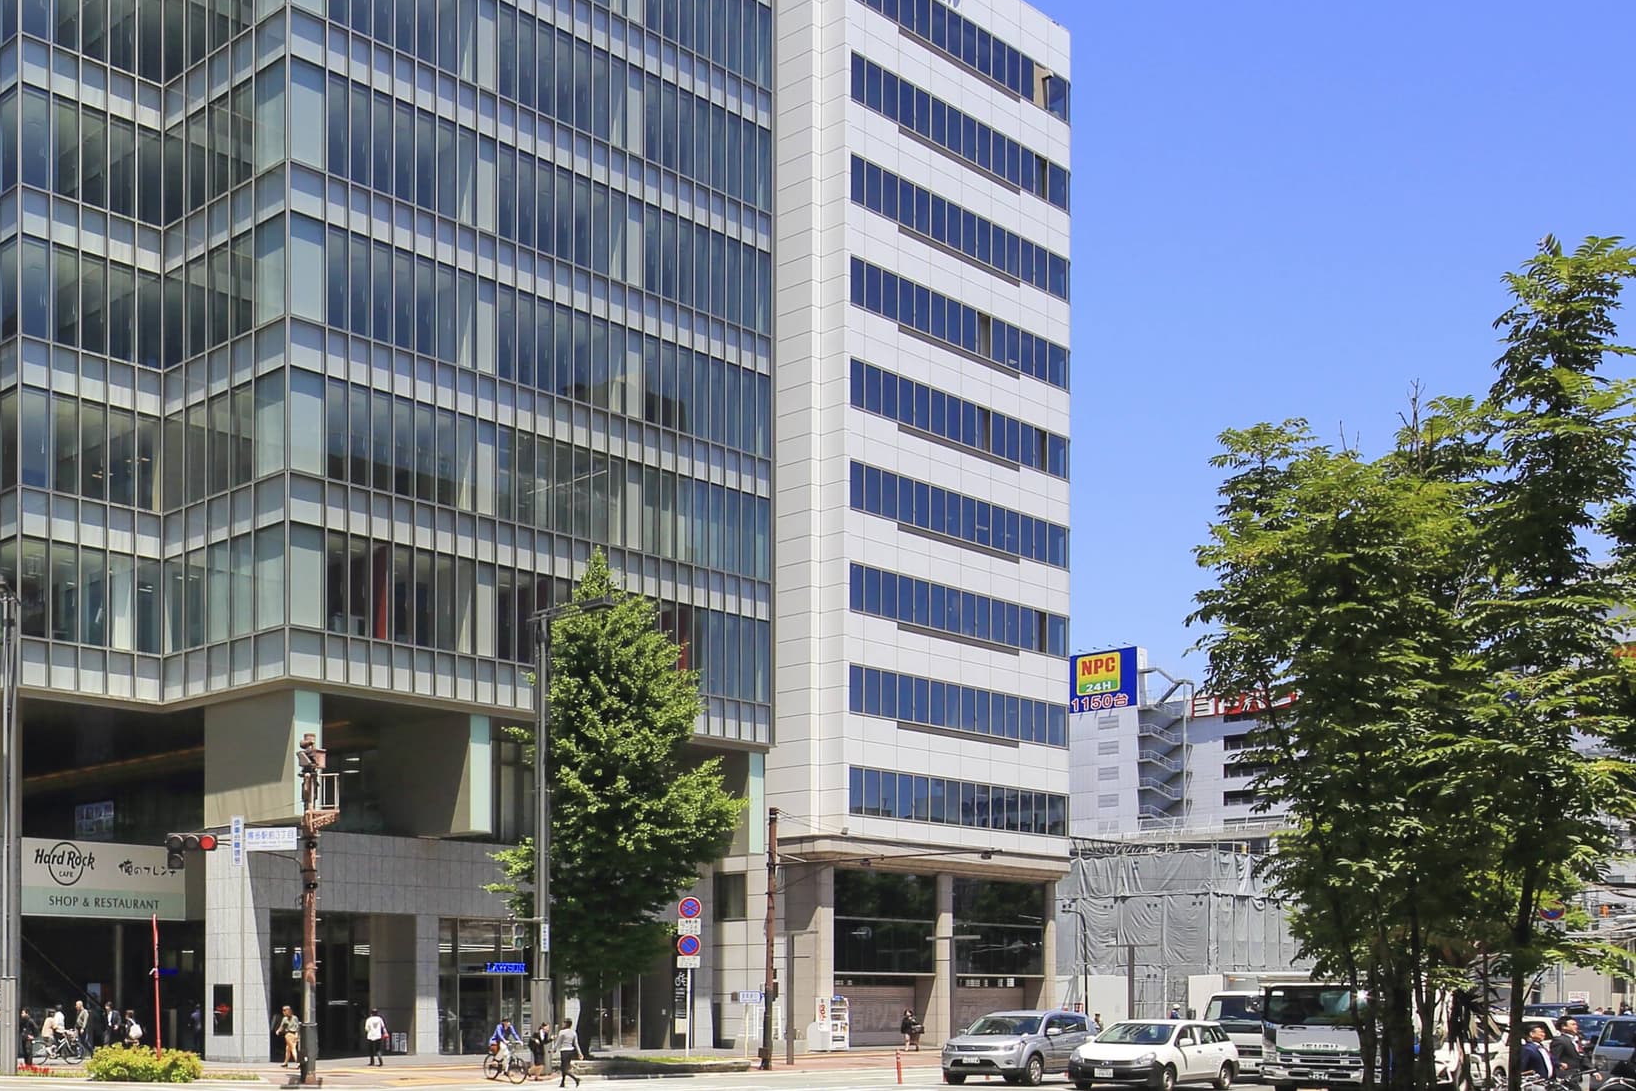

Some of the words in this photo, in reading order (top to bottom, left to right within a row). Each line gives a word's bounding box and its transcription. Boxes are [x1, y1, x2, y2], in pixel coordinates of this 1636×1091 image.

[1080, 656, 1116, 677] NPC
[1085, 681, 1112, 693] 24H
[1070, 693, 1129, 713] 1150台
[34, 848, 66, 865] Hard
[67, 850, 95, 870] Rock
[49, 895, 79, 907] SHOP
[82, 897, 90, 908] &
[94, 898, 160, 910] RESTAURANT
